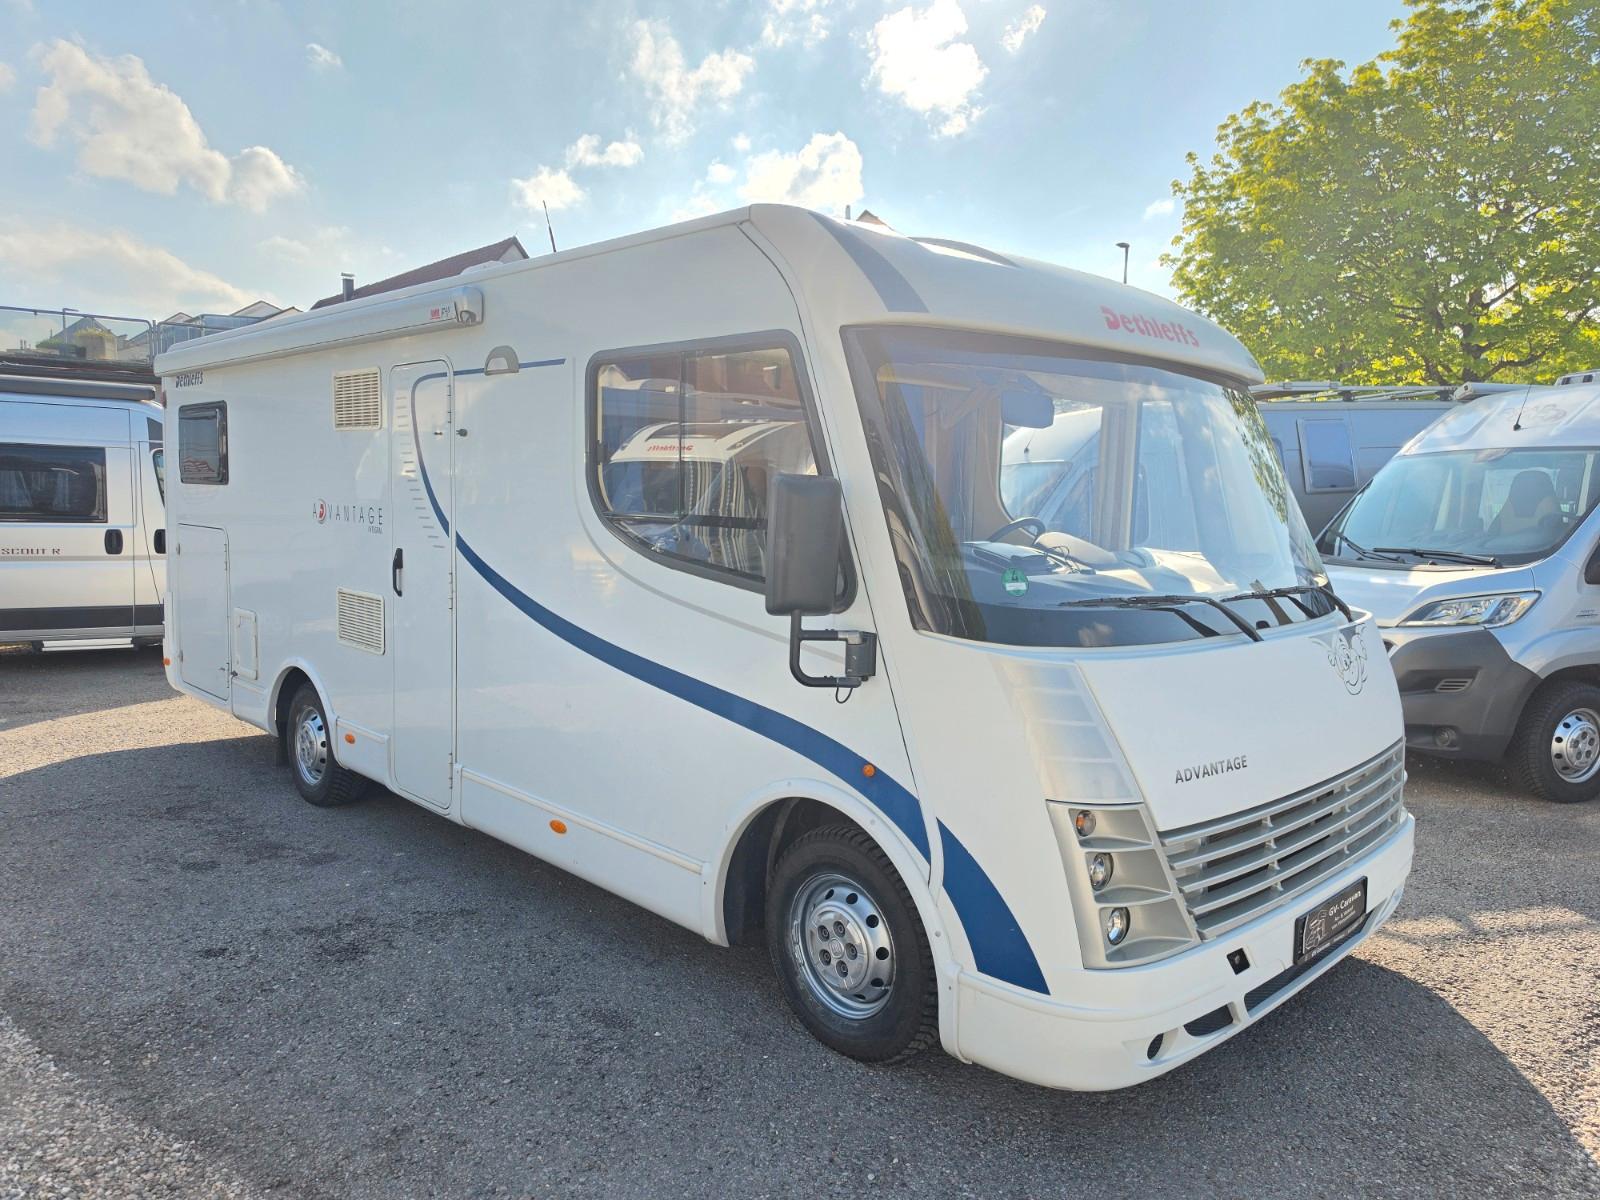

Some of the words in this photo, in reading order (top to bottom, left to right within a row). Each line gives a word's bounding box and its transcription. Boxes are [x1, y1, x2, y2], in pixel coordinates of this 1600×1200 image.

[1101, 305, 1199, 347] Dethleffs
[312, 499, 384, 526] ADVANTAGE
[1174, 755, 1248, 784] ADVANTAGE
